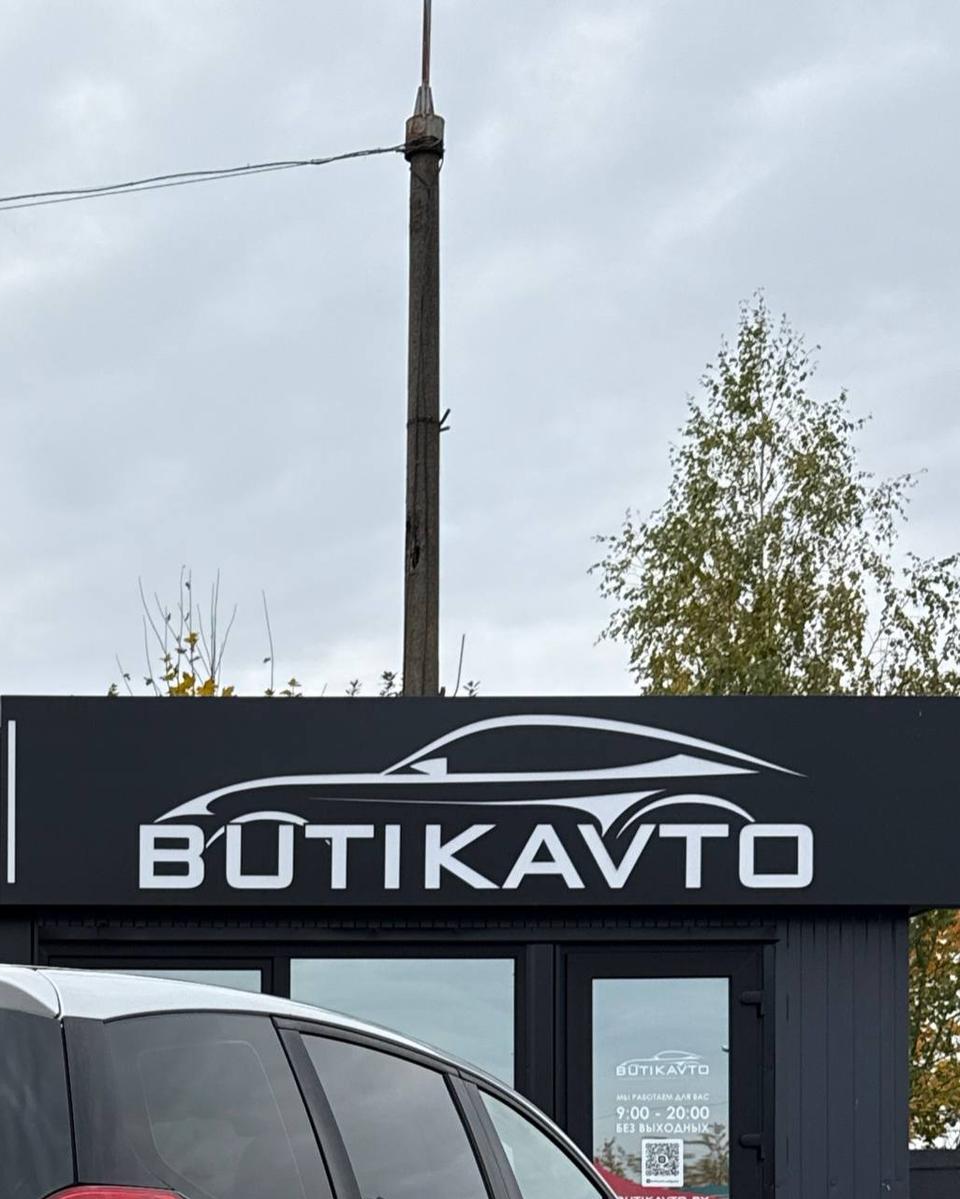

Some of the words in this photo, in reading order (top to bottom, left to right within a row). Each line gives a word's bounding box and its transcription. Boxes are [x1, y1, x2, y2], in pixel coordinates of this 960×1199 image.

[138, 822, 815, 890] BUTIKAVTO
[616, 1064, 710, 1076] BUTIKAVTO
[616, 1093, 631, 1101] МЫ
[632, 1093, 673, 1101] РАБОТАЕМ
[675, 1093, 692, 1101] ДЛЯ
[693, 1093, 710, 1101] ВАС
[616, 1106, 650, 1120] 9:00
[666, 1106, 710, 1120] 20:00
[616, 1123, 636, 1134] БЕЗ
[639, 1123, 709, 1134] ВЫХОДНЫХ
